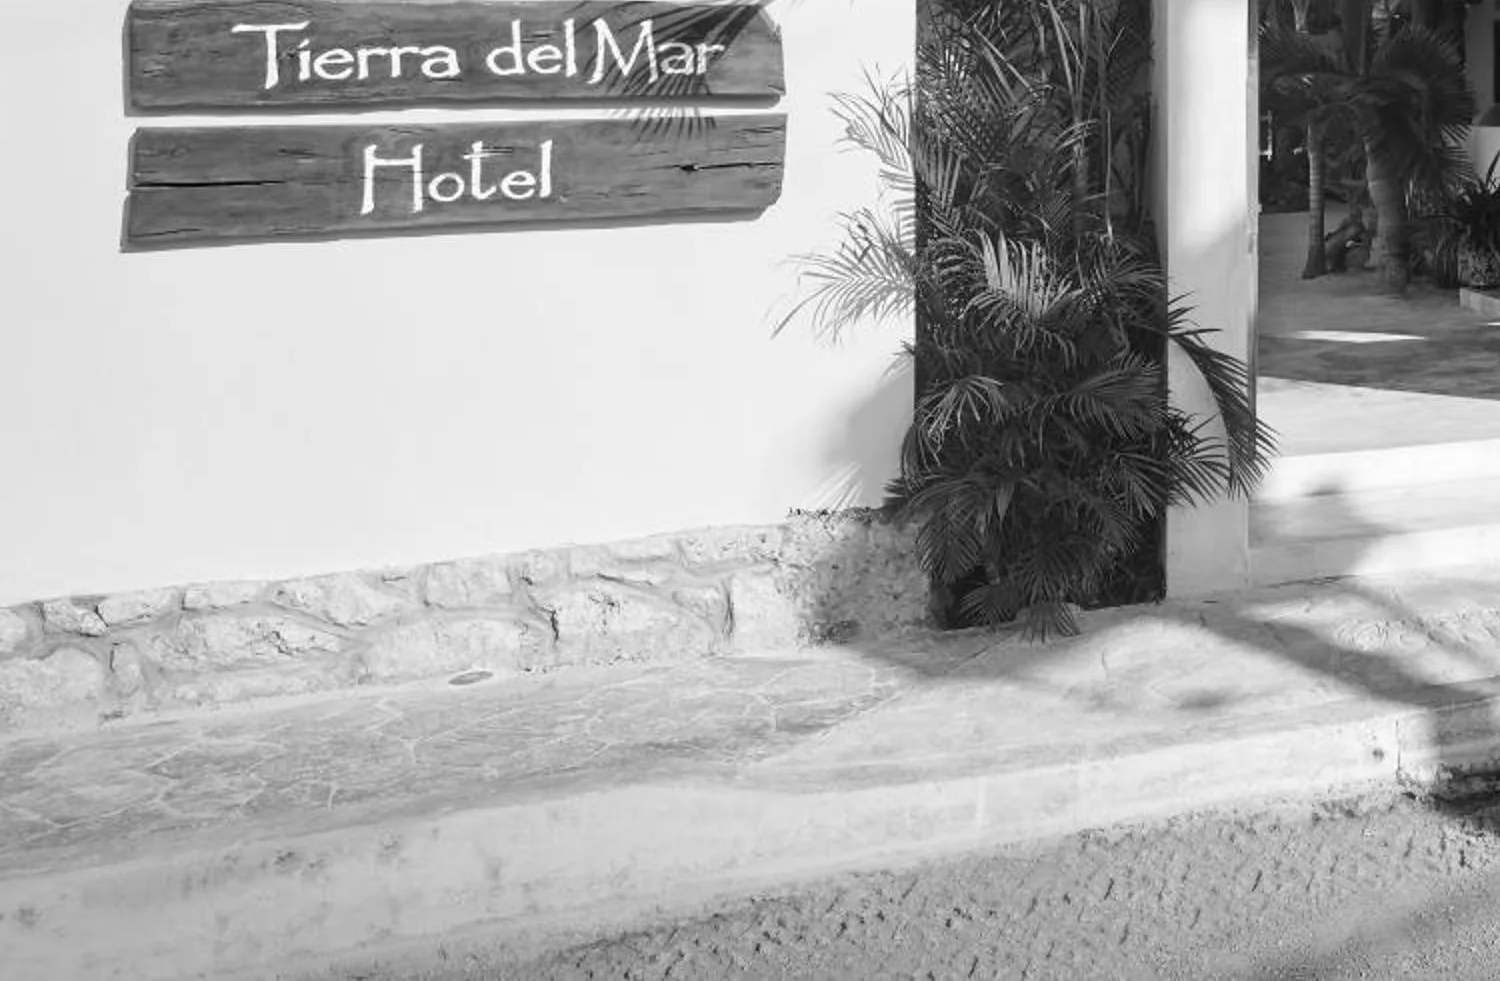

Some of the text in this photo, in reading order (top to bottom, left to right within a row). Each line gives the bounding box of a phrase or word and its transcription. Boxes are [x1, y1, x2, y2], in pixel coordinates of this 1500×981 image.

[231, 17, 725, 90] Tierra del Mar
[360, 139, 554, 214] Hotel
